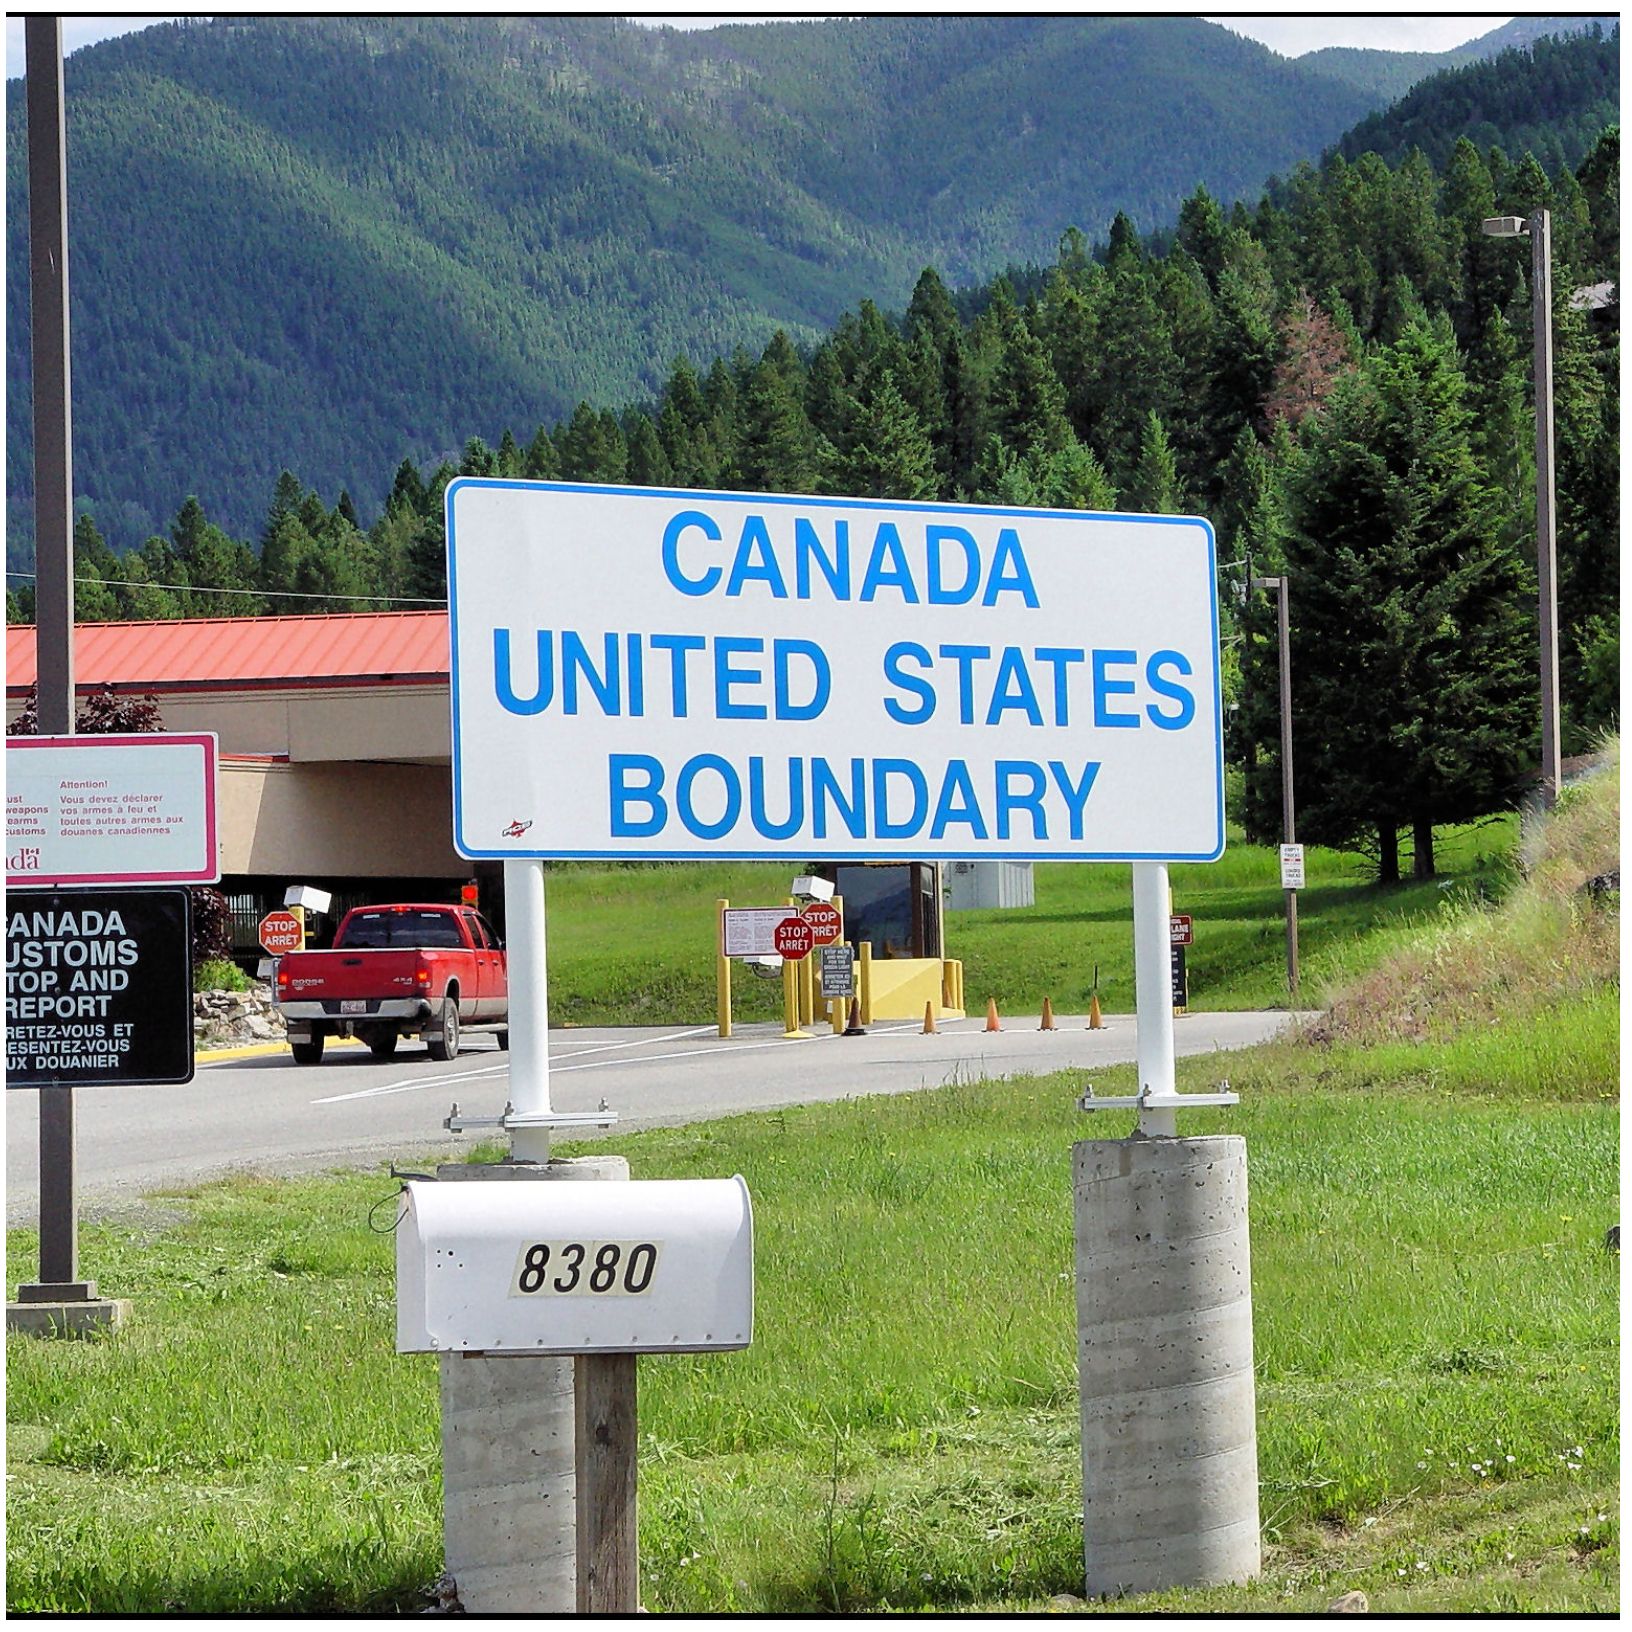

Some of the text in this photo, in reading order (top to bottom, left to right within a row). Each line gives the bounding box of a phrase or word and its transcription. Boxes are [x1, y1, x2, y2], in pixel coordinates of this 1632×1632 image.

[662, 510, 1041, 608] CANADA
[494, 628, 1196, 731] UNITED STATES
[60, 780, 108, 789] Attention!
[60, 794, 163, 804] Vous devez déclarer
[608, 753, 1102, 842] BOUNDARY
[60, 807, 78, 815] vos
[127, 805, 143, 814] feu
[147, 805, 157, 813] et
[60, 817, 91, 825] toutes
[95, 817, 127, 825] autres
[166, 816, 184, 824] aux
[60, 826, 170, 836] douanes canadiennes
[804, 912, 837, 922] STOP
[6, 910, 127, 938] ANADA
[265, 920, 297, 932] STOP
[813, 924, 838, 936] RRÊT
[779, 926, 808, 938] STOP
[264, 933, 299, 946] ARRÊT
[779, 938, 808, 950] ARRÊT
[6, 969, 129, 993] TOP AND
[6, 995, 112, 1019] REPORT
[113, 1023, 134, 1036] ET
[6, 1039, 130, 1055] ESENTEZ-VOUS
[35, 1054, 119, 1069] DOUANIER
